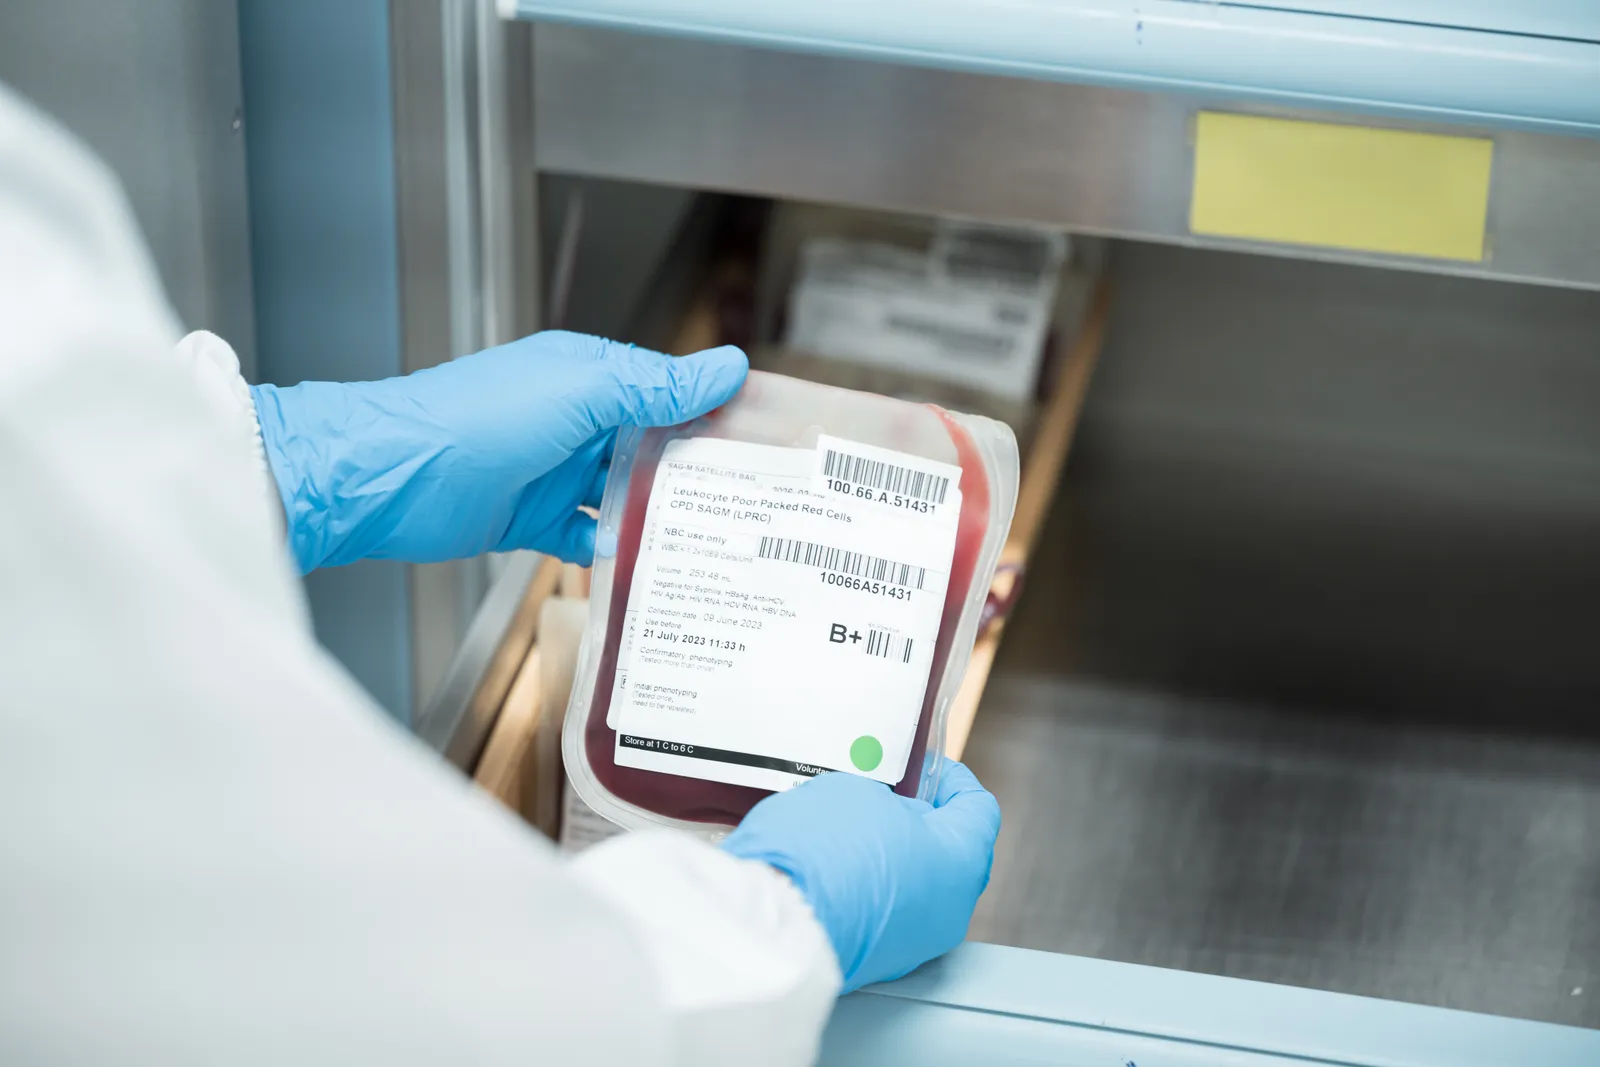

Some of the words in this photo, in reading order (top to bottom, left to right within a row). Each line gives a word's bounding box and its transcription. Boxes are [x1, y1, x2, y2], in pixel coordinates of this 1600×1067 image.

[668, 462, 693, 471] SAG-M
[695, 464, 736, 478] SATELLITE
[738, 473, 756, 481] BAG
[673, 486, 728, 503] Leukocyte
[732, 495, 757, 507] Poor
[760, 499, 799, 511] Packed
[801, 503, 823, 515] Red
[826, 509, 852, 523] Cells
[827, 478, 937, 515] 100.66.A.51431
[670, 500, 694, 511] CPD
[697, 504, 730, 517] SAGM
[733, 510, 772, 524] (LPRC)
[664, 527, 685, 537] NBC
[687, 532, 704, 541] use
[706, 535, 727, 546] only
[652, 579, 682, 590] Negative
[684, 583, 693, 591] for
[820, 571, 912, 601] 10066A51431
[651, 590, 664, 598] HIV
[689, 595, 702, 603] HIV
[724, 601, 741, 609] HCV
[761, 606, 780, 615] HBV
[779, 609, 797, 619] DNA
[645, 619, 659, 627] Use
[660, 620, 682, 630] before
[647, 606, 681, 617] Collection
[682, 611, 697, 620] date
[703, 612, 715, 622] 09
[716, 614, 738, 626] June
[740, 618, 763, 630] 2023
[643, 628, 654, 638] 21
[657, 630, 679, 643] July
[682, 634, 706, 646] 2023
[709, 638, 736, 651] 11:33
[739, 643, 746, 652] h
[829, 623, 862, 644] B+
[640, 646, 685, 660] Confirmatory
[689, 654, 734, 668] phenotyping
[634, 682, 652, 691] Initial
[653, 685, 698, 699] phenotyping
[632, 700, 648, 708] need
[649, 700, 656, 708] to
[656, 701, 665, 710] be
[624, 735, 645, 746] Store
[646, 740, 654, 748] at
[656, 741, 660, 749] 1
[662, 742, 669, 750] C
[671, 743, 679, 751] to
[680, 744, 686, 752] 6
[687, 745, 694, 754] C
